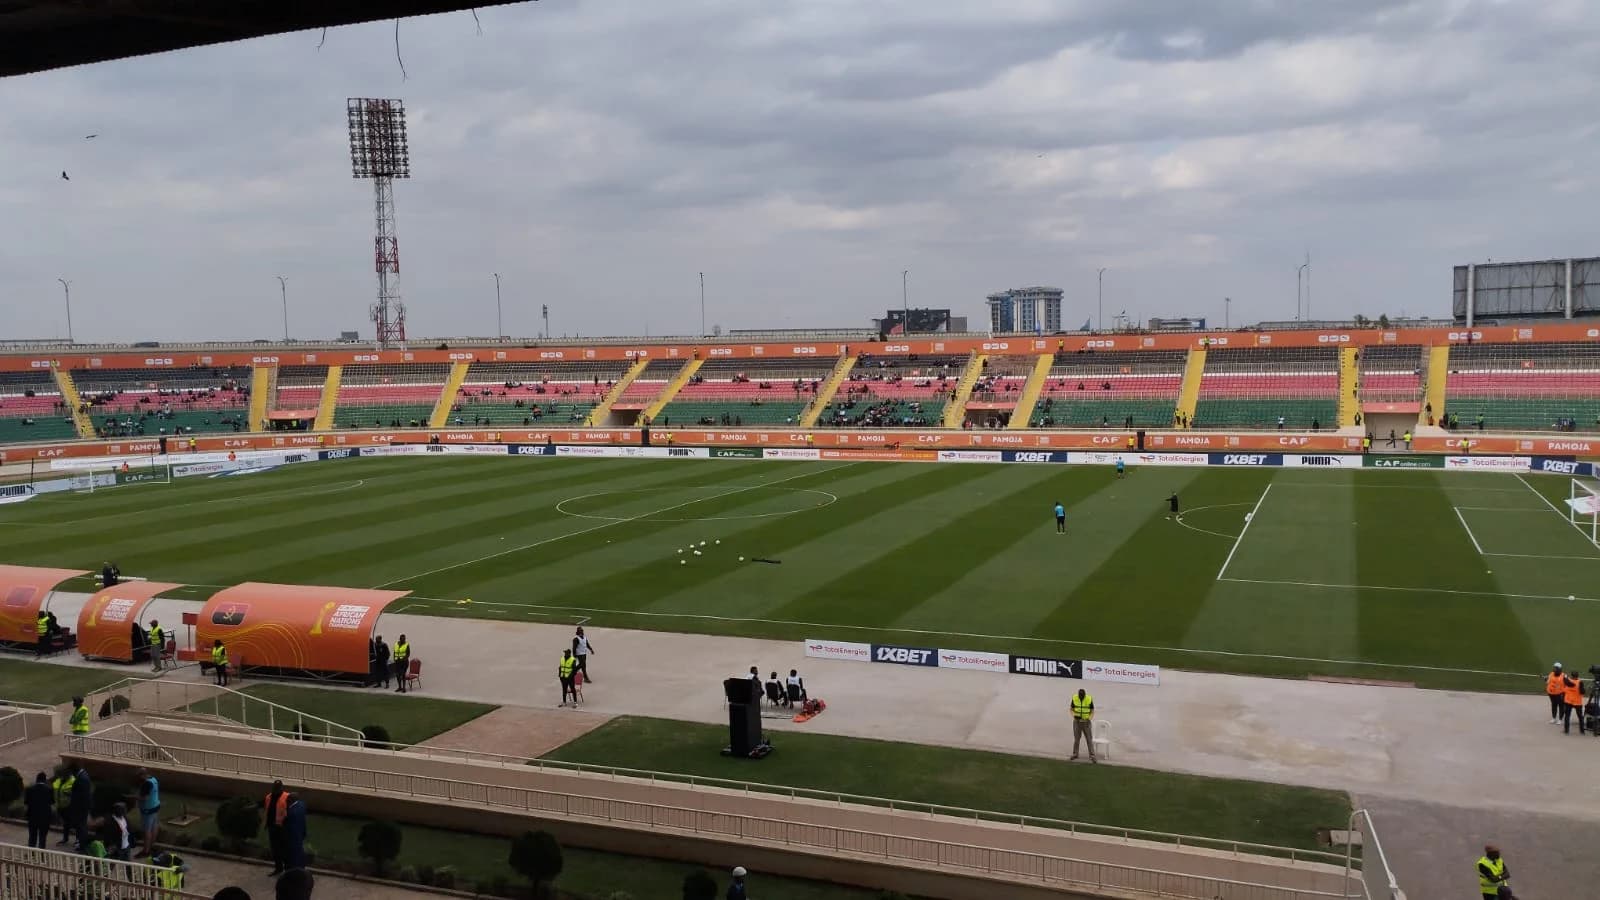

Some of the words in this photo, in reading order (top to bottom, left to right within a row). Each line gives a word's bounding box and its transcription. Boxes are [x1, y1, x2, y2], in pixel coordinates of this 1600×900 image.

[1092, 436, 1119, 444] CAF
[1175, 436, 1210, 444] PAMOJA
[1279, 437, 1308, 445] CAF
[1548, 442, 1591, 451] PAMOJA
[37, 449, 65, 457] CAF
[668, 448, 689, 456] PUMA
[1015, 452, 1054, 462] 1XBET
[1158, 455, 1204, 464] TotalEnergies
[1223, 454, 1268, 465] 1XBET
[1301, 456, 1331, 466] PUMA
[1472, 458, 1528, 468] TotalEnergies
[1543, 460, 1580, 474] 1XBET
[824, 646, 868, 656] TotalEnergies
[876, 647, 932, 664] 1XBET
[958, 656, 1006, 667] TotalEnergies
[1016, 658, 1057, 674] PUMA
[1104, 668, 1156, 679] TotalEnergies
